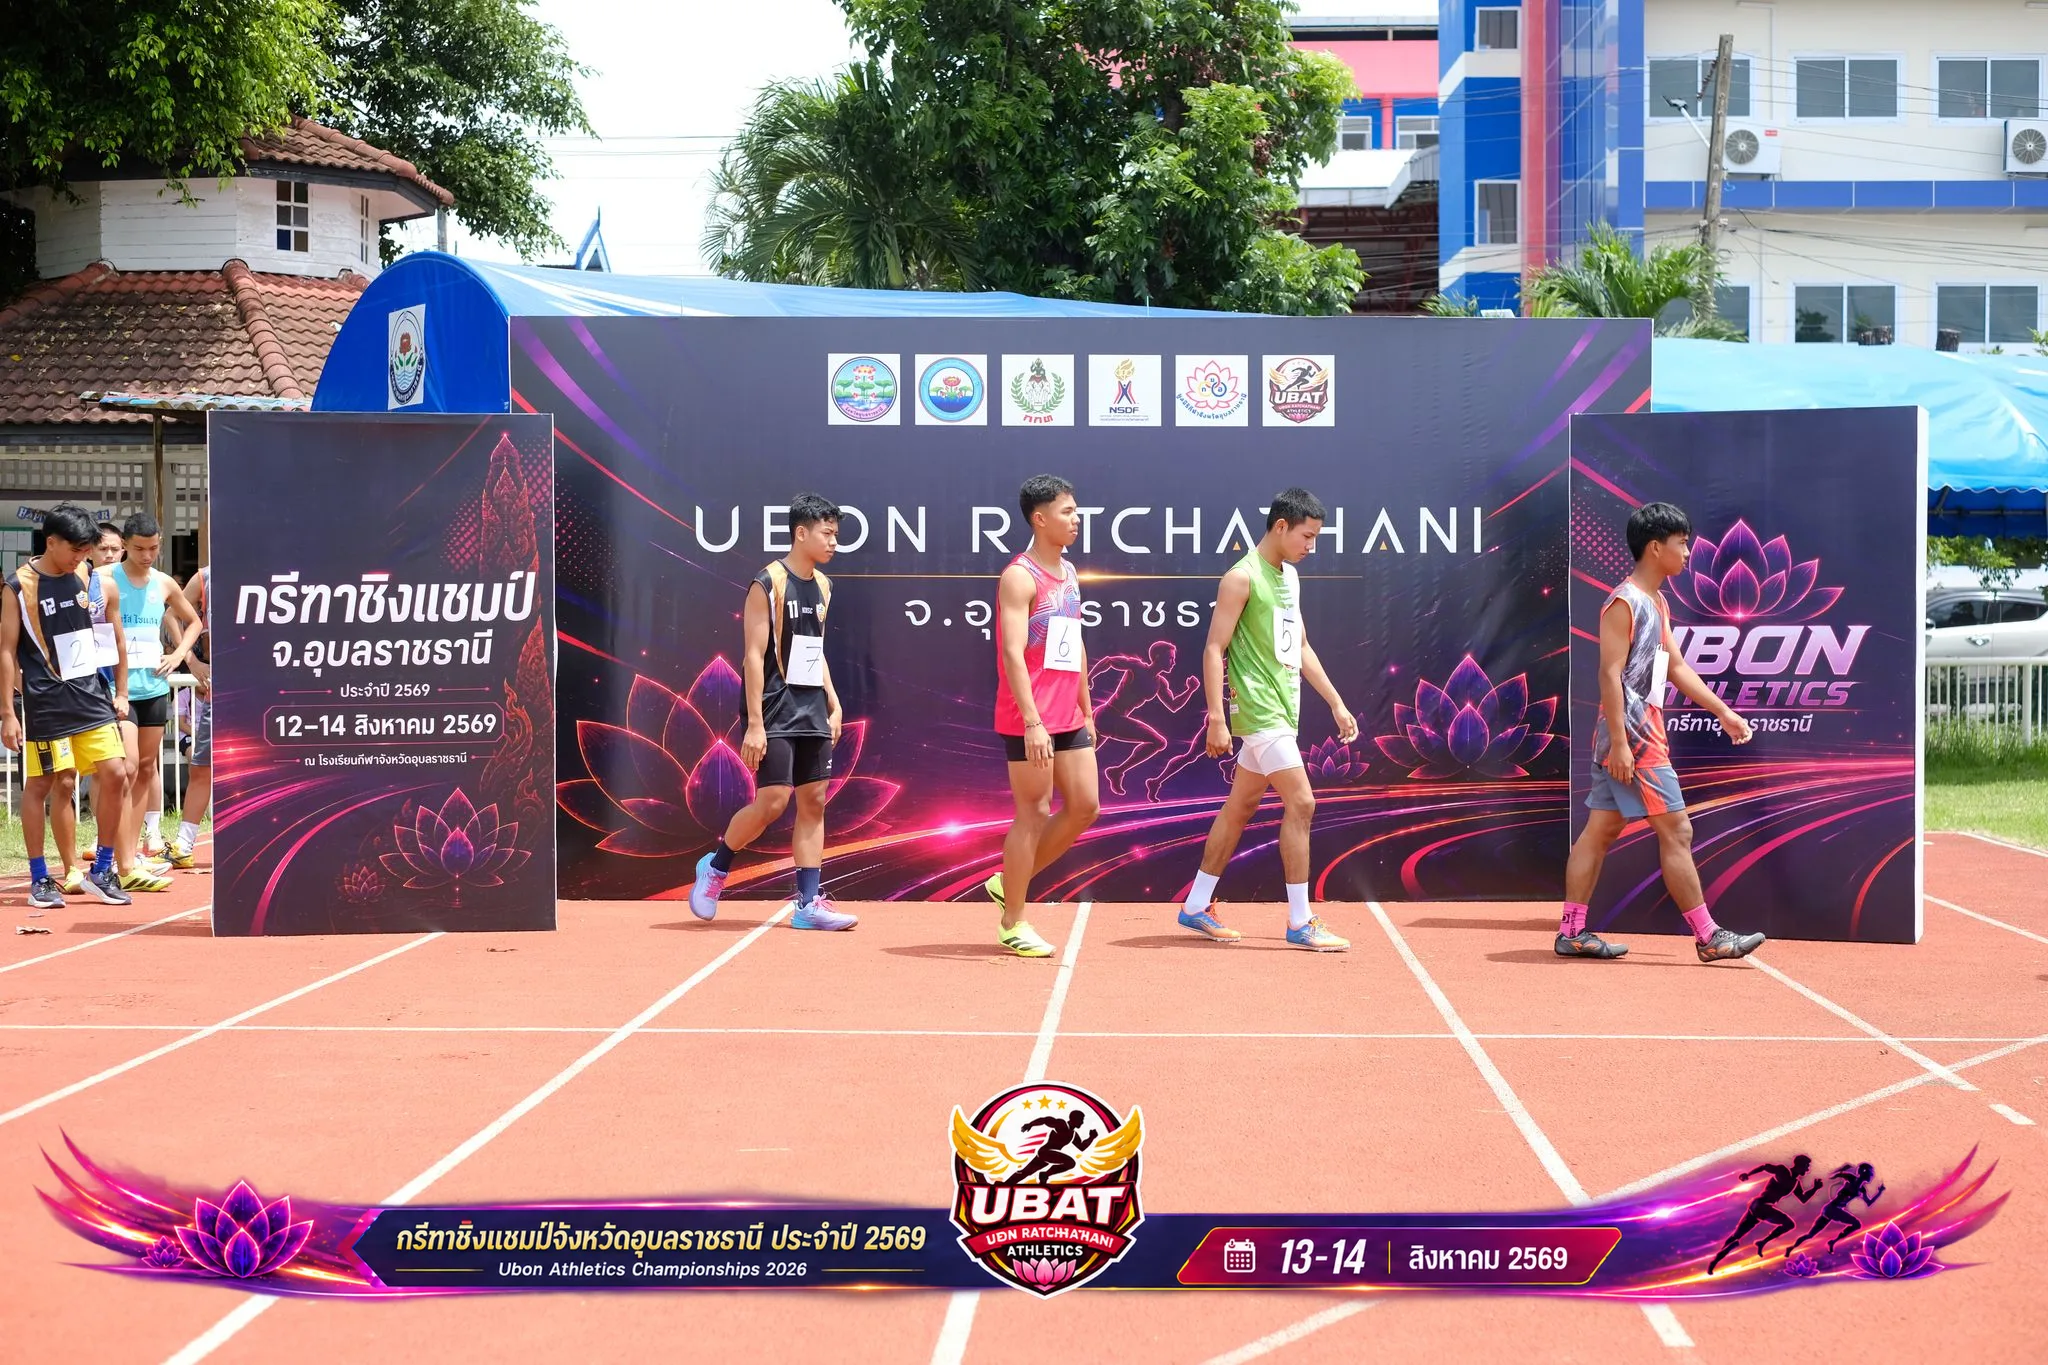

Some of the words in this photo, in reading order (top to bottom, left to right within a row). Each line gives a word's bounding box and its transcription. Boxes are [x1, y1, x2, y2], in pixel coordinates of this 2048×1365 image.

[1274, 391, 1324, 404] UBAT
[1023, 414, 1054, 424] กกท
[1109, 406, 1140, 415] NSDF
[971, 507, 1482, 554] RTCHAHANI
[39, 597, 57, 617] 12
[236, 571, 536, 624] กรีฑาชิงแชมป์
[787, 600, 799, 619] 11
[1058, 625, 1070, 658] 6
[1280, 618, 1295, 653] 5
[70, 639, 86, 669] 2
[127, 636, 143, 659] 4
[273, 629, 494, 678] จ.อุบลราชธานี
[806, 646, 822, 672] 7
[340, 683, 390, 699] ประจำปี
[394, 684, 431, 697] 2569
[354, 714, 435, 736] สิงหาคม
[442, 713, 497, 734] 2569
[304, 757, 316, 767] ณ
[318, 751, 467, 768] โรงเรียนกีฬาจังหวัดอุบลราชธานี
